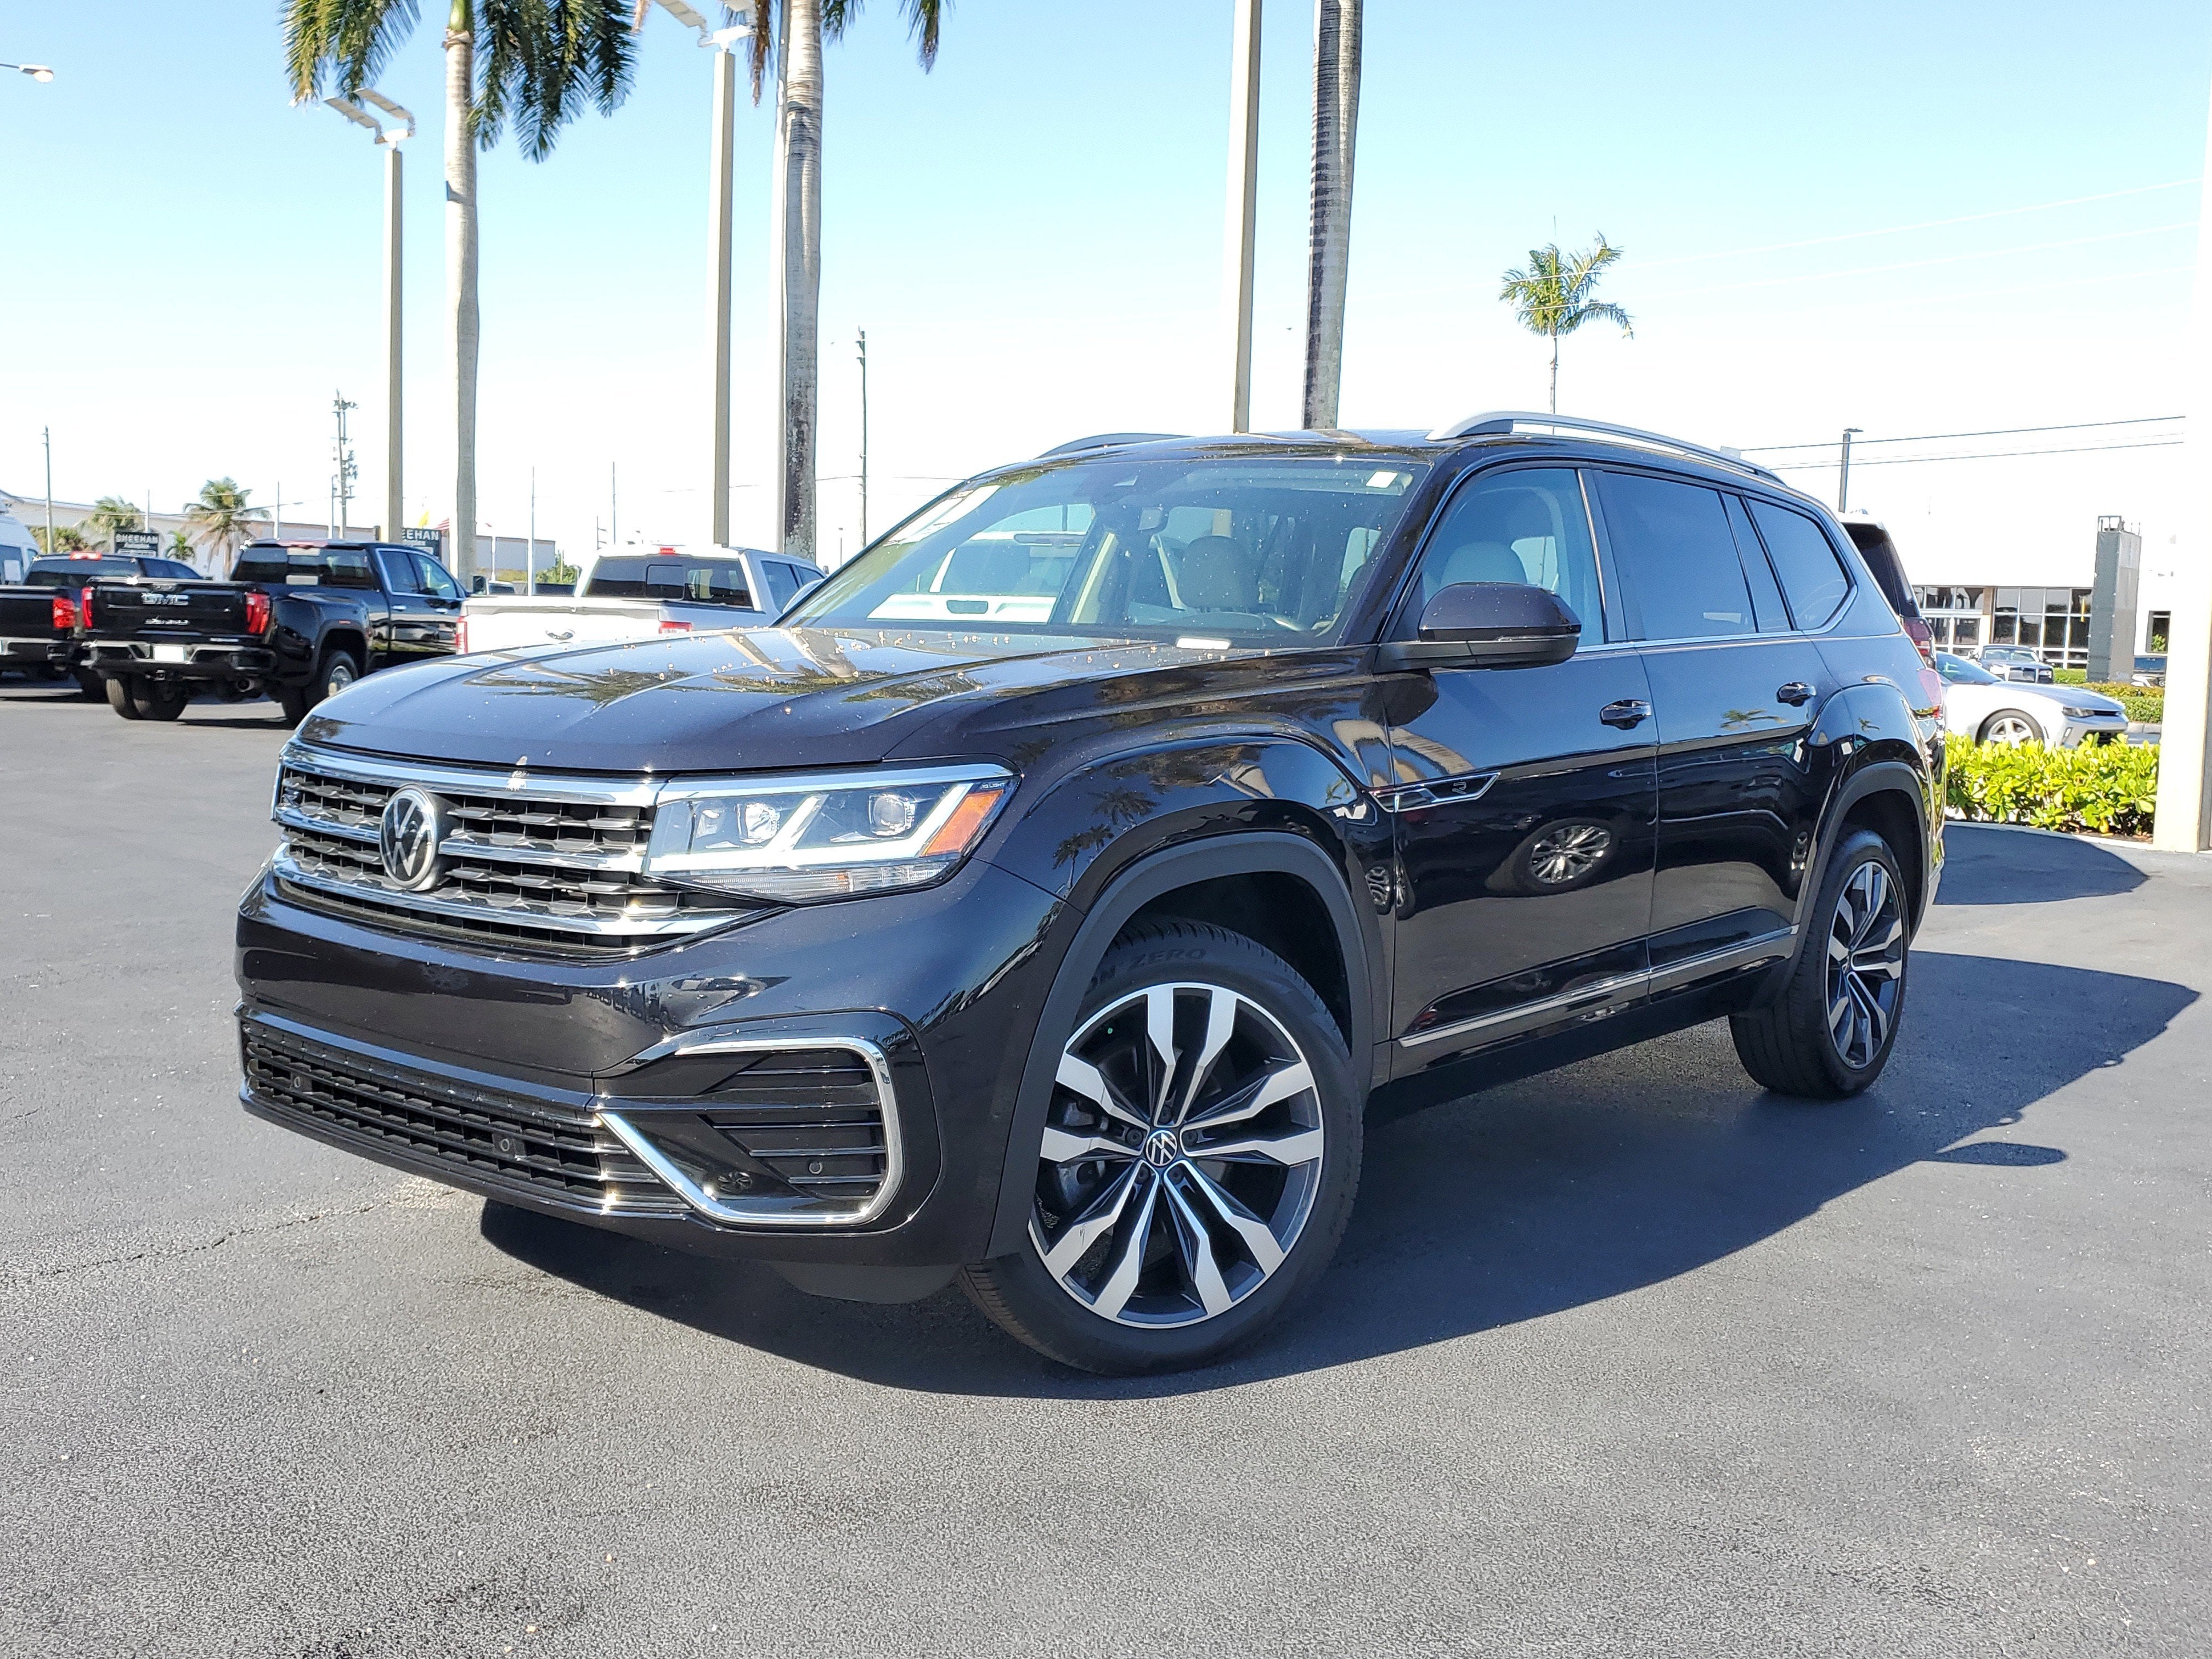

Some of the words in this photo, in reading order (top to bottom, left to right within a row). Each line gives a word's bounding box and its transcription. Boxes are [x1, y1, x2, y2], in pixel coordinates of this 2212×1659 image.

[402, 529, 439, 540] EHAN
[142, 592, 189, 606] GMC
[1127, 948, 1207, 972] ZERO
